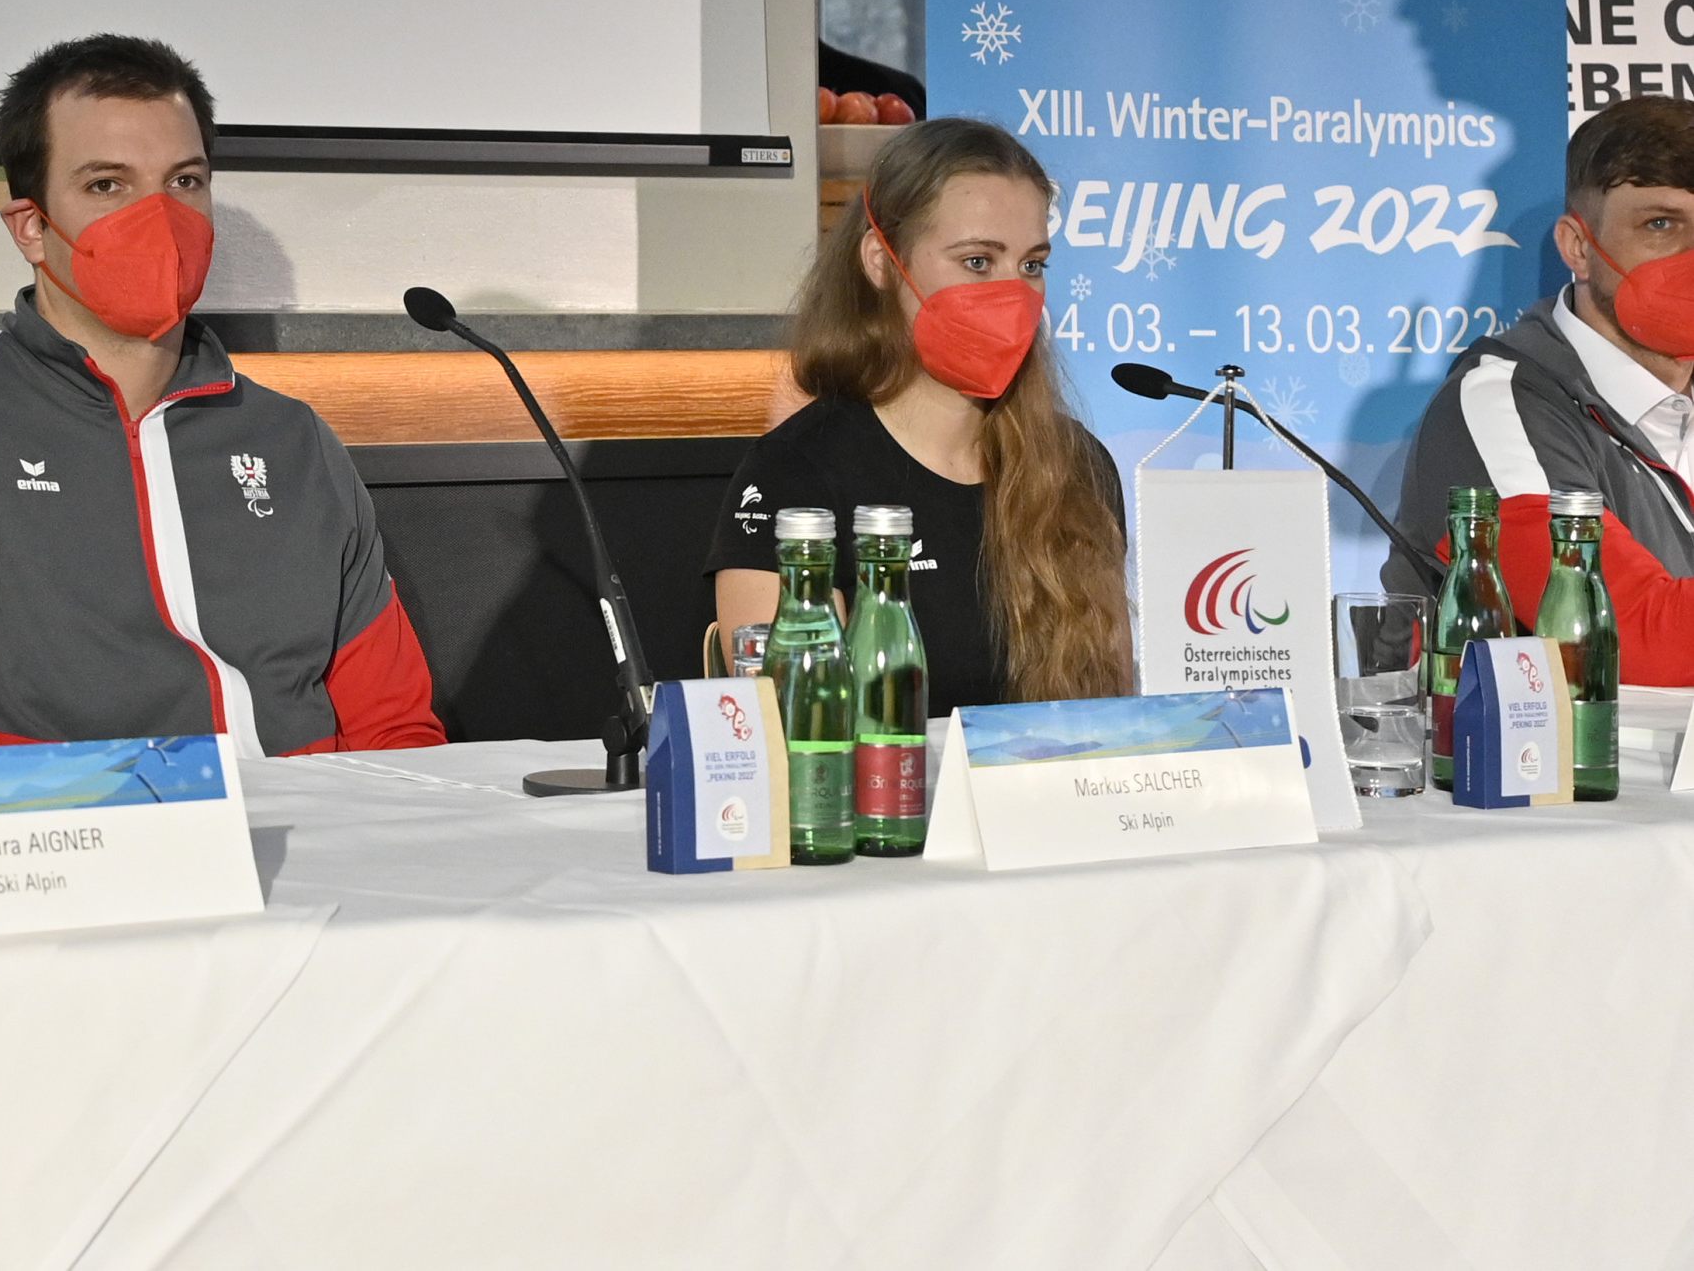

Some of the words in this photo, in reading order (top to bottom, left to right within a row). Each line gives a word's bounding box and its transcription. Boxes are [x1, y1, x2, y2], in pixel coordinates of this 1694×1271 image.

[1017, 88, 1097, 137] XIII.
[1106, 91, 1496, 158] Winter-Paralympics
[742, 150, 779, 162] STIERS
[1307, 184, 1521, 258] 2022
[1386, 305, 1498, 355] 2022
[17, 478, 61, 492] erima
[908, 559, 939, 571] ima
[1183, 642, 1291, 663] Österreichisches
[1184, 665, 1292, 686] Paralympisches
[1073, 777, 1131, 798] Markus
[1133, 768, 1204, 794] SALCHER
[1118, 814, 1140, 832] Ski
[1142, 811, 1175, 832] Alpin
[28, 827, 105, 855] AIGNER
[24, 870, 68, 895] Alpin
